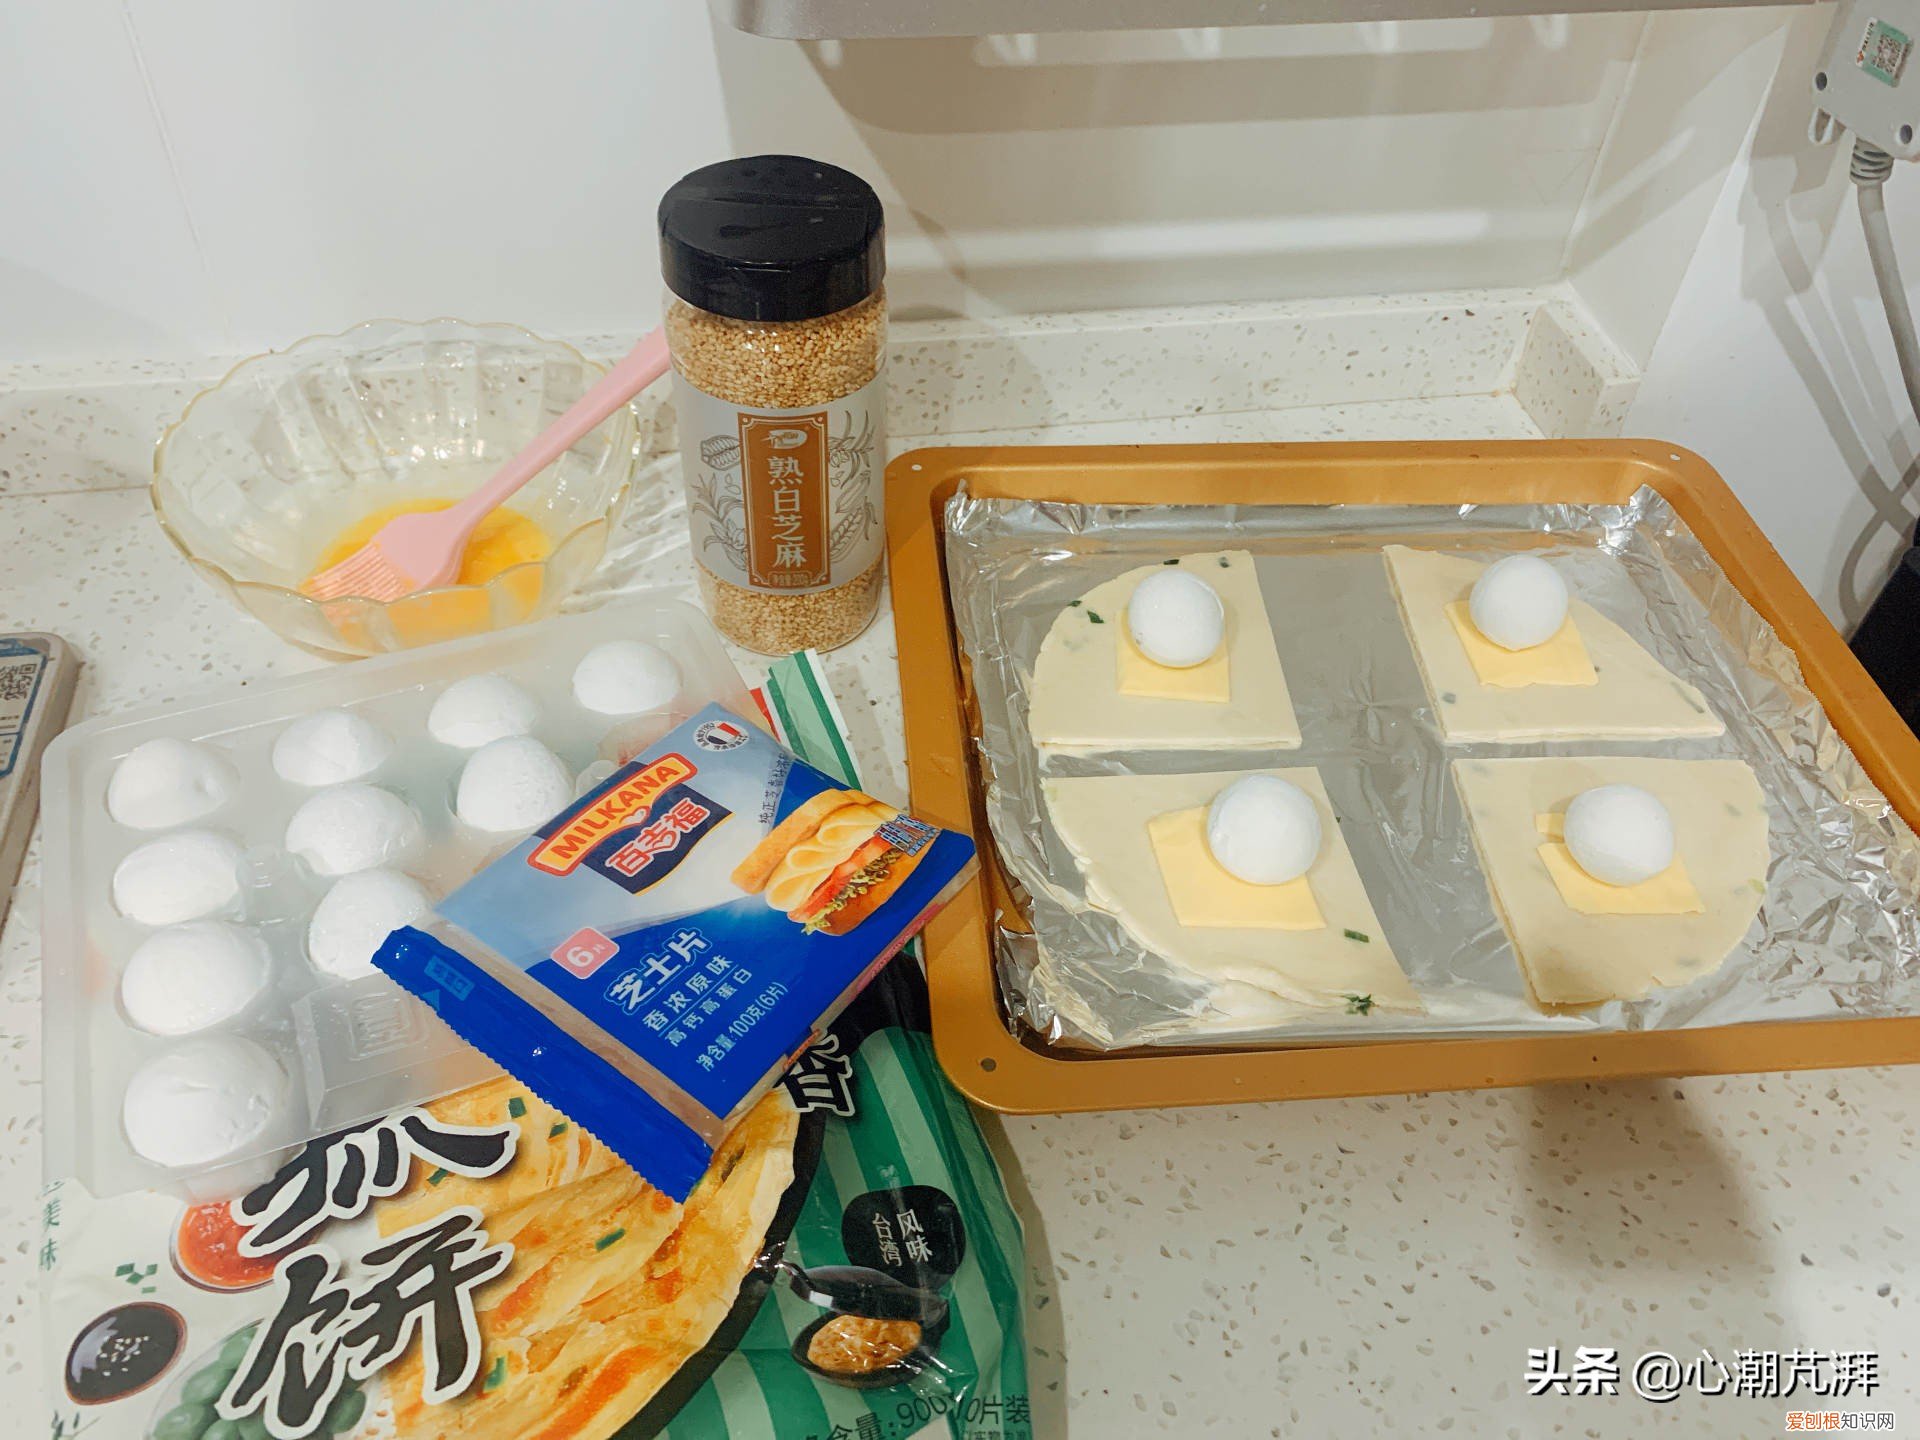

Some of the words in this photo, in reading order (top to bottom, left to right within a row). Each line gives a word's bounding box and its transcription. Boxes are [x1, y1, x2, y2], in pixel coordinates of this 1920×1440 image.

[767, 456, 807, 569] 熟白芝麻
[550, 765, 681, 859] MILKANA
[606, 798, 710, 876] 百吉福
[610, 930, 707, 1010] 芝士片
[642, 955, 733, 1032] 香浓原味
[665, 968, 752, 1047] 高钙高蛋白
[897, 1209, 933, 1262] 风味
